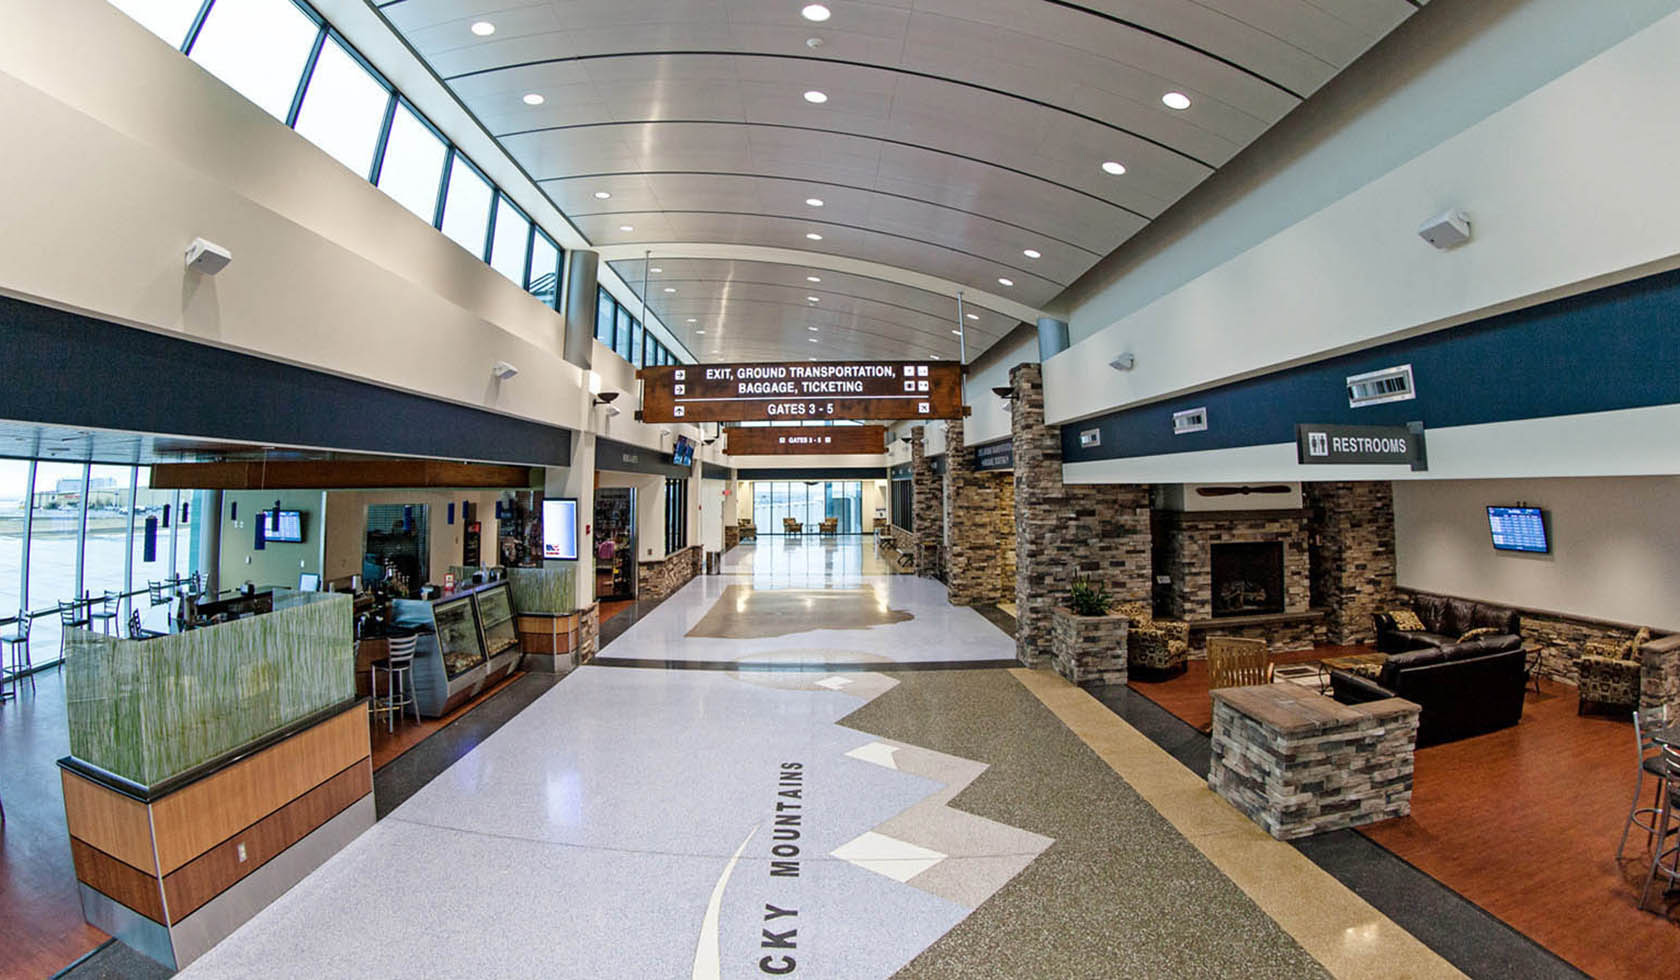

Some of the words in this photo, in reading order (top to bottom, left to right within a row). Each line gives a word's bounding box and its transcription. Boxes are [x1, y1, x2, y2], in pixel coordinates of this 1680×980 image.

[706, 368, 734, 382] EXIT,
[737, 367, 786, 379] GROUND
[788, 366, 896, 380] TRANSPORTATION,
[738, 382, 798, 395] BAGGAGE,
[801, 381, 863, 393] TICKETING
[767, 403, 806, 415] GATES
[809, 403, 816, 414] 3
[826, 403, 834, 414] 5
[1332, 436, 1407, 453] RESTROOMS
[769, 762, 803, 877] MOUNTAINS
